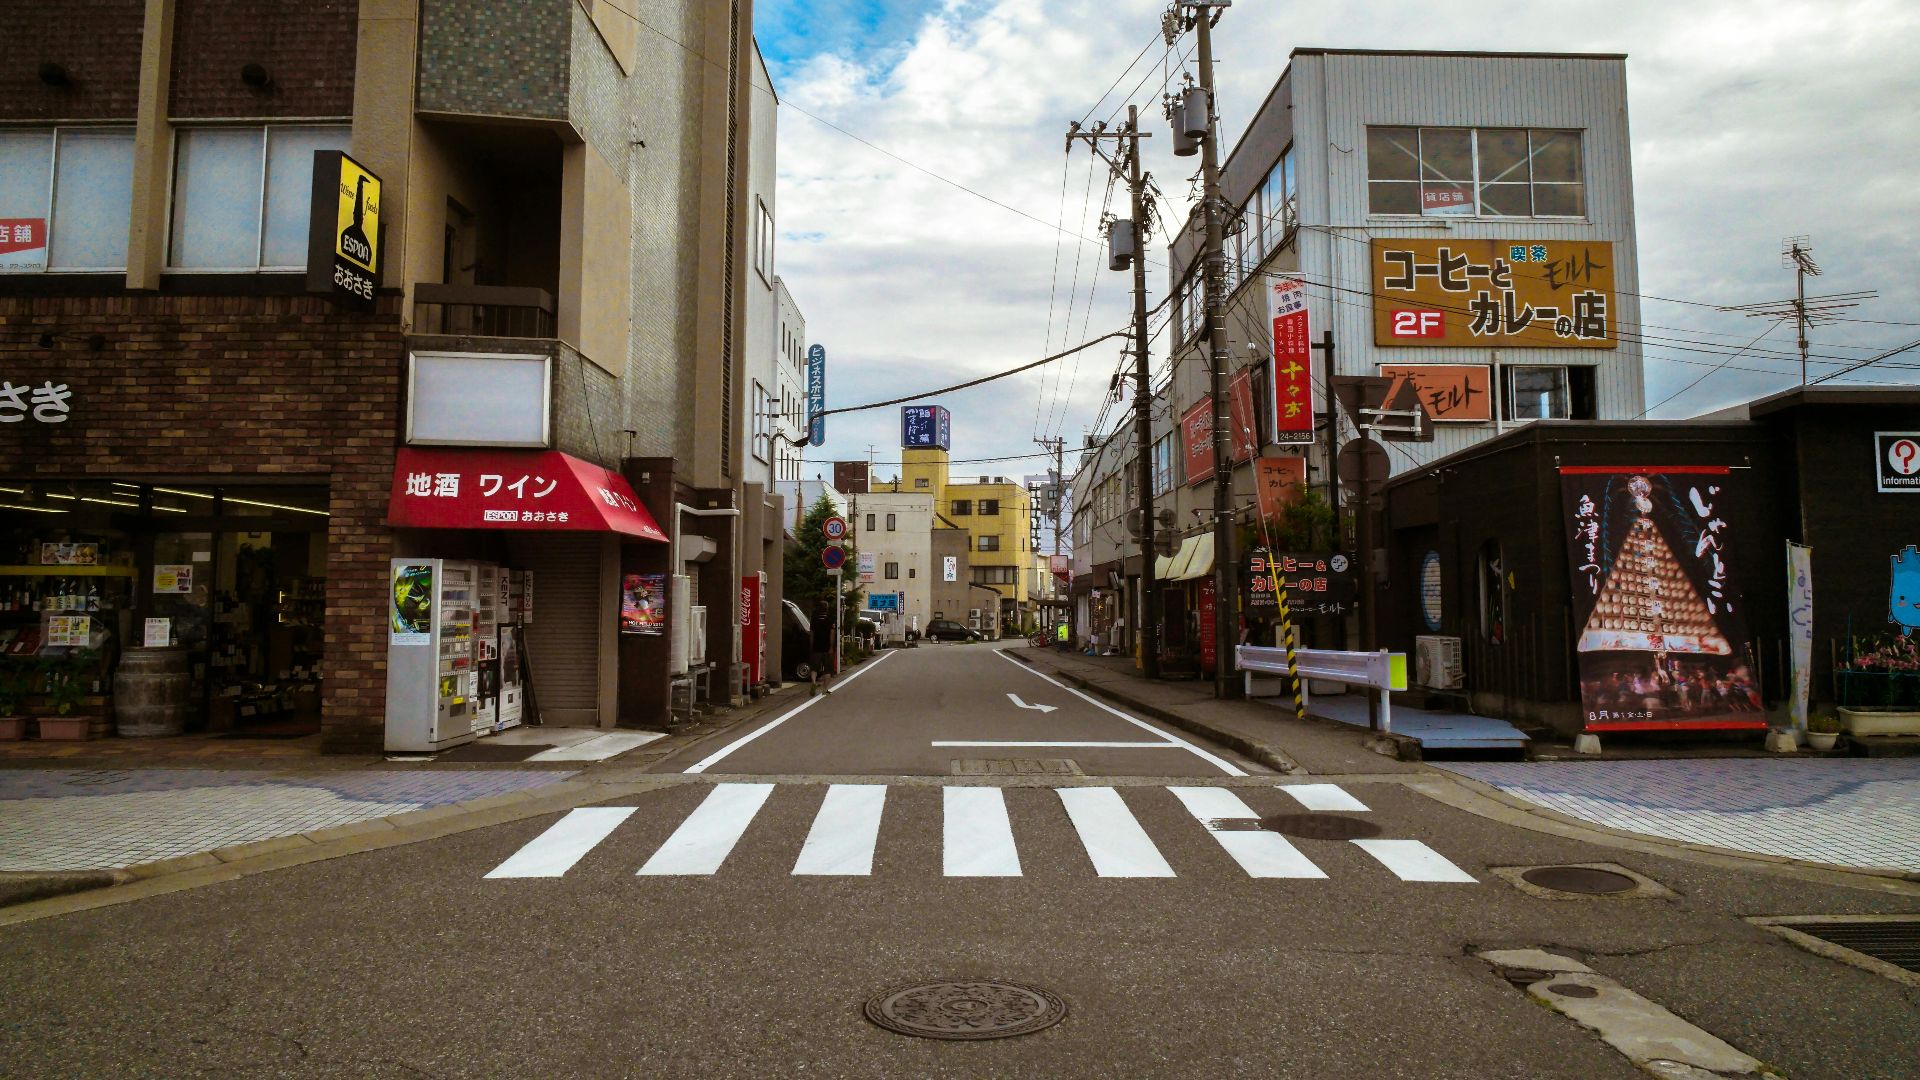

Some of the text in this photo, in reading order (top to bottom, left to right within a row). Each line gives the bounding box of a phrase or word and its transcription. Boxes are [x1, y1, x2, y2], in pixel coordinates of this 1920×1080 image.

[343, 235, 369, 262] ESPOA
[1510, 245, 1548, 262] 喫茶
[334, 263, 374, 300] おおさき
[1384, 247, 1513, 291] コーヒーと
[1541, 247, 1606, 291] モルト
[1394, 311, 1441, 335] 2F
[1469, 290, 1608, 339] カレーの店
[811, 347, 822, 413] ビジネスホテル
[1428, 375, 1483, 415] モルト
[1280, 433, 1310, 441] 24-2156
[405, 472, 557, 499] 地酒 ワイン
[521, 511, 570, 522] おおさき
[828, 523, 842, 534] 30
[1574, 494, 1601, 595] 魚津まつり
[1250, 576, 1328, 592] カレーの店
